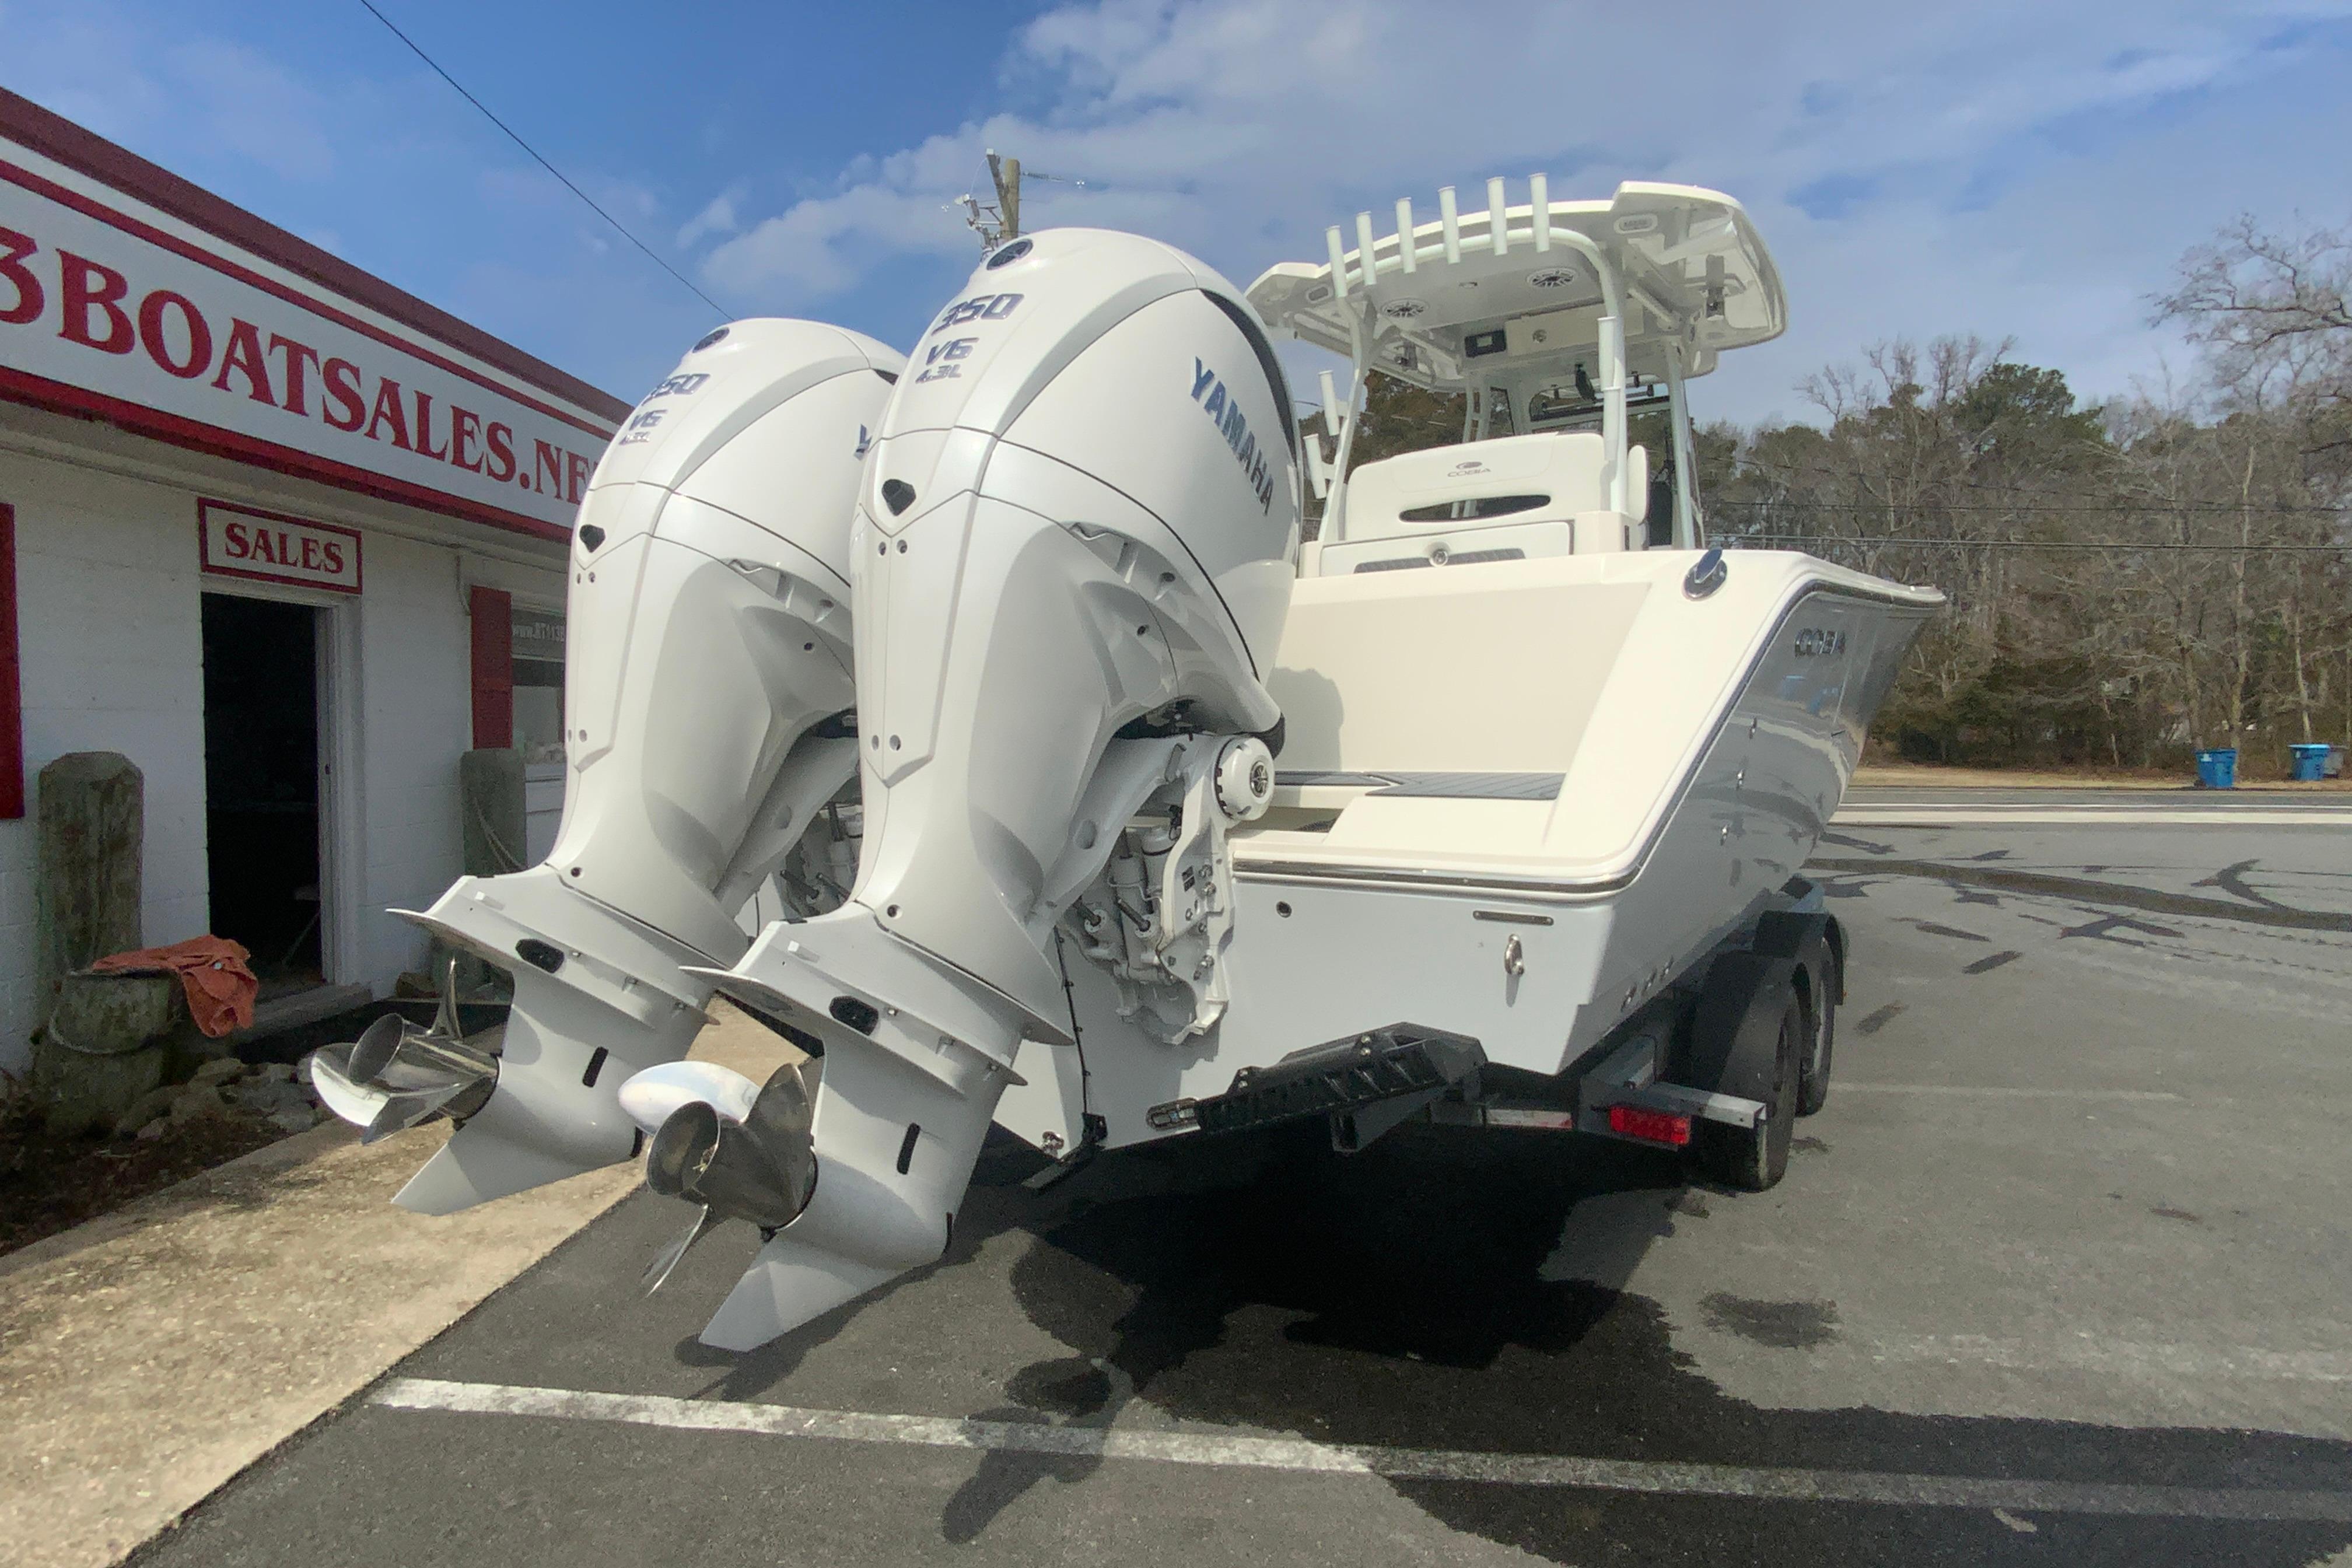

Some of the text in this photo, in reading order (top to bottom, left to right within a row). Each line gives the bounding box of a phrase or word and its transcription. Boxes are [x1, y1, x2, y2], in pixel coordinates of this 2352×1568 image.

[932, 293, 1024, 336] 350
[926, 337, 979, 366] V6
[1191, 355, 1273, 517] YAMAHA
[225, 523, 344, 574] SALES
